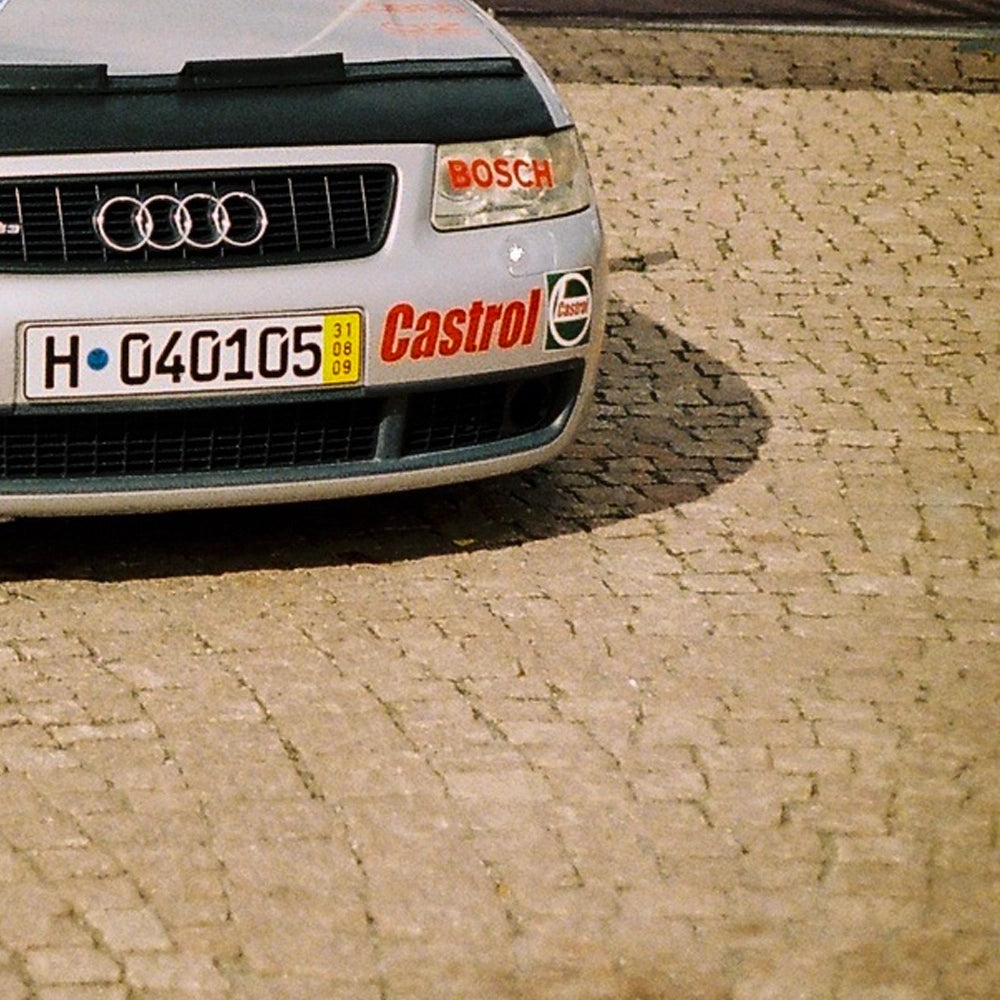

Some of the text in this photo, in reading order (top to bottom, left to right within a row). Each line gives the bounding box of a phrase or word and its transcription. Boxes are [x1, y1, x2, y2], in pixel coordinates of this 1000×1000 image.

[446, 157, 554, 190] BOSCH
[333, 321, 351, 338] 31
[379, 288, 542, 363] Castrol
[333, 341, 352, 357] 08
[332, 359, 352, 375] 09
